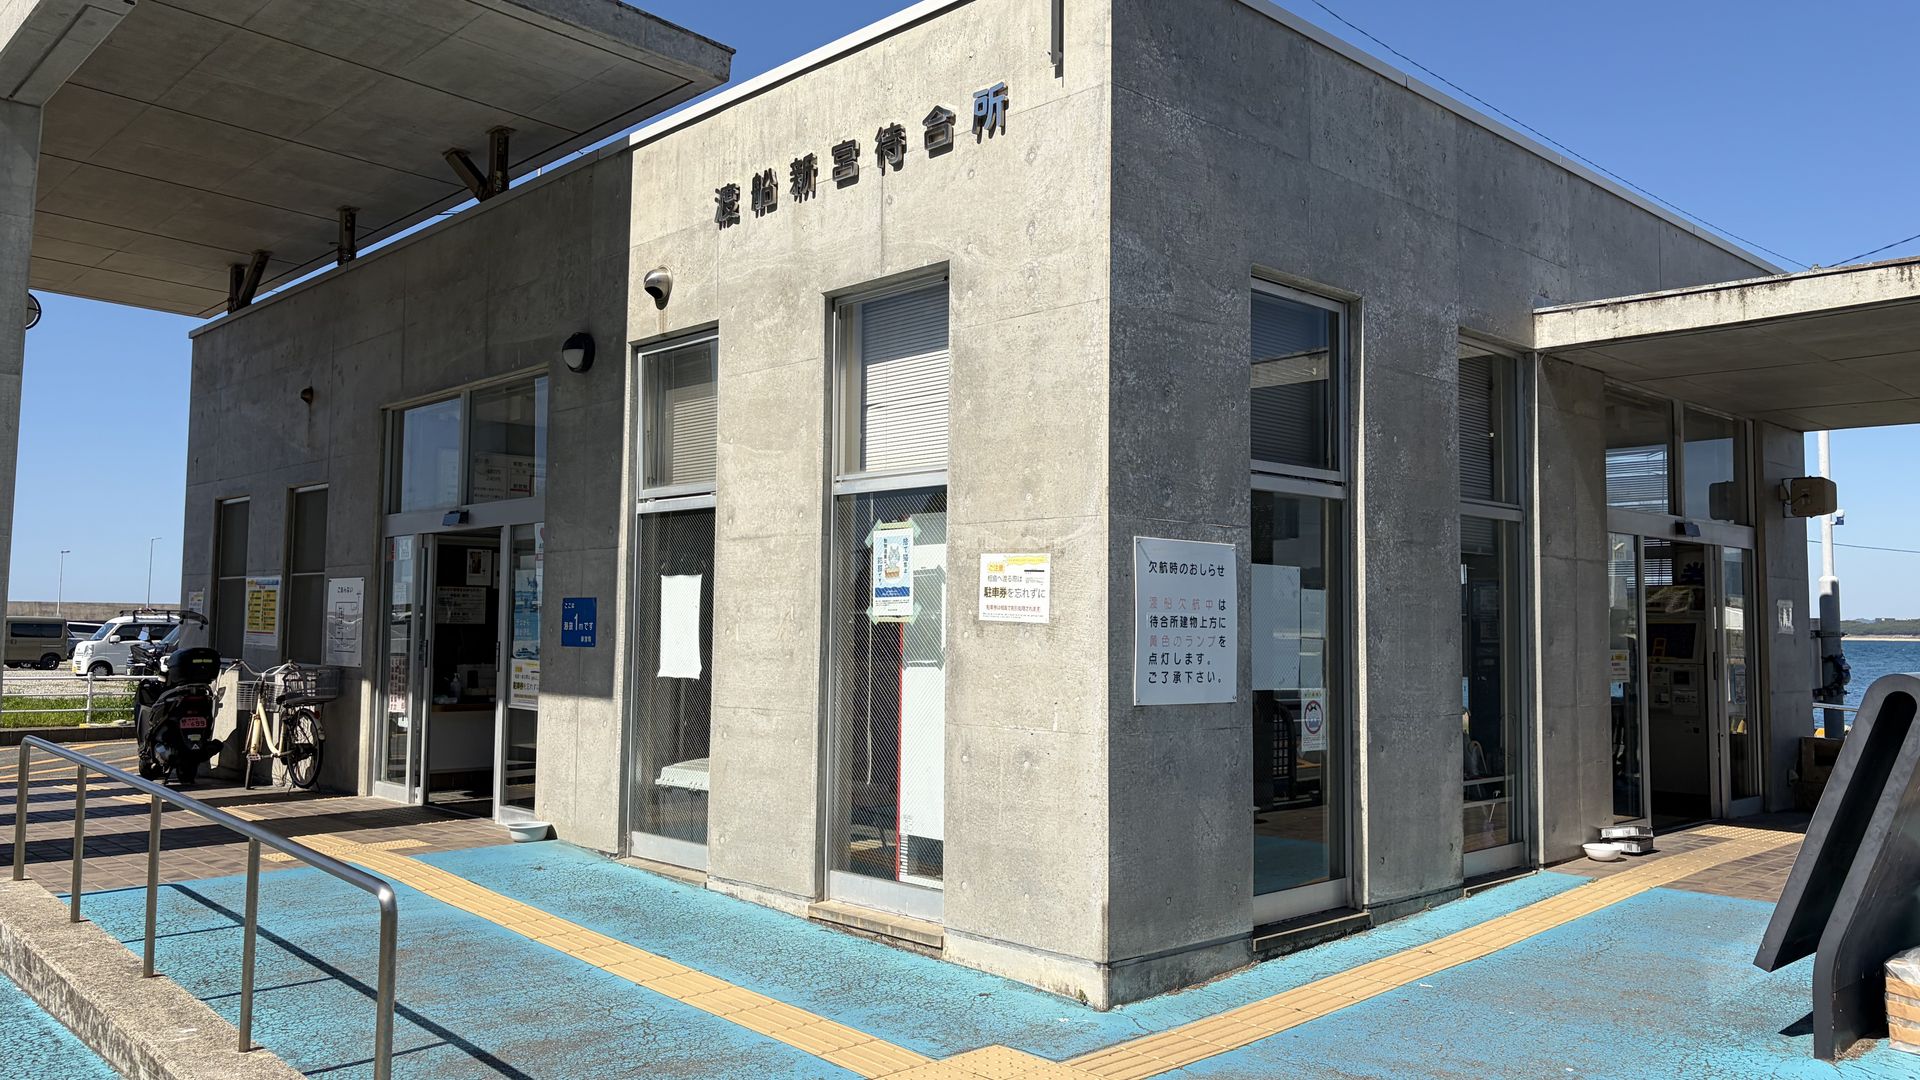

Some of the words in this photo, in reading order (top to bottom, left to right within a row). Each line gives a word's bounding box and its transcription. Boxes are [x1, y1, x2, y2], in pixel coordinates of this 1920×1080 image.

[715, 82, 1008, 229] 渡船新宮待合所
[1148, 561, 1225, 577] 欠航時のおしらせ
[984, 586, 1046, 599] 駐車券を忘れずに
[1149, 597, 1226, 611] 渡船欠航中は
[1149, 615, 1227, 629] 待合所建物上方に
[1148, 652, 1211, 666] 点灯します。
[1148, 671, 1222, 684] ご了承下さい。
